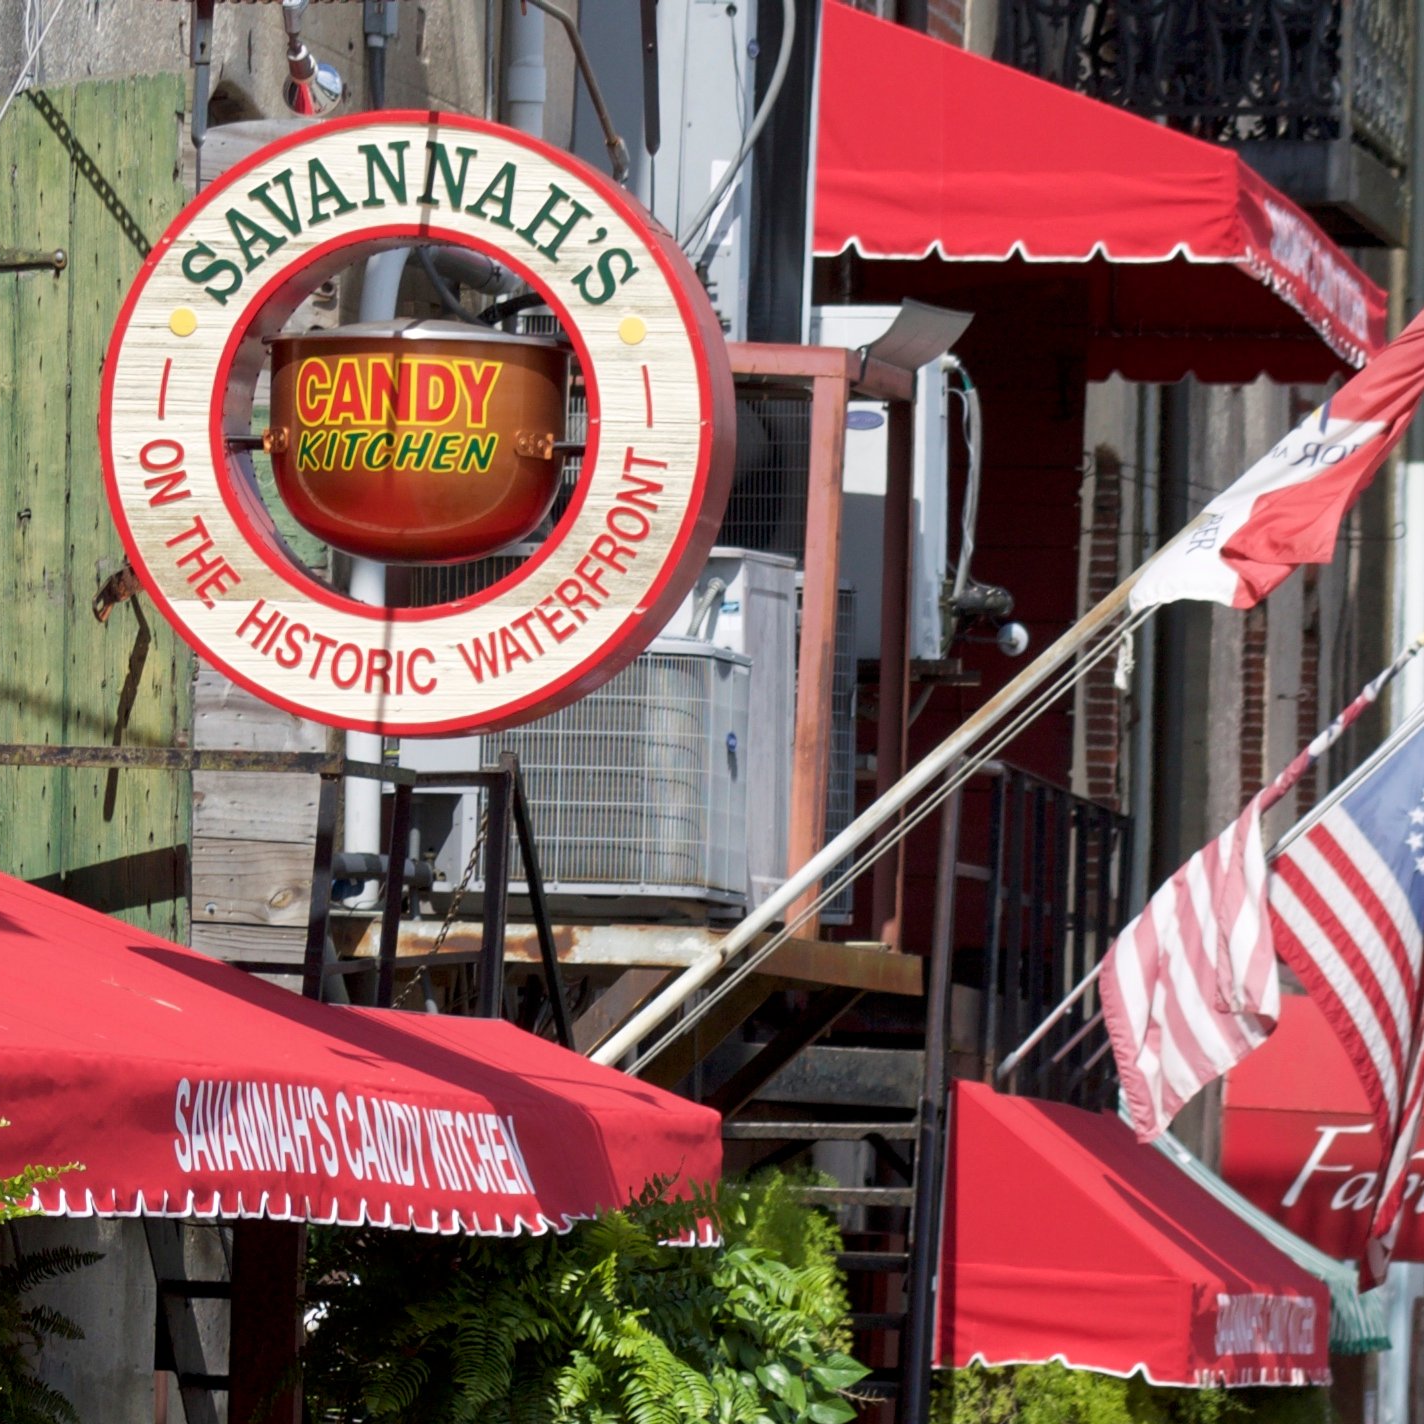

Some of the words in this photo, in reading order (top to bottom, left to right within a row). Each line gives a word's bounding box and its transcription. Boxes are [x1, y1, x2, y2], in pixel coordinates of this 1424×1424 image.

[180, 139, 640, 307] SAVANNAH'S
[296, 355, 503, 429] CANDY
[138, 437, 192, 509] ON
[296, 429, 499, 475] KITCHEN
[164, 514, 242, 611] THE
[455, 446, 670, 686] WATERFRONT
[235, 596, 438, 697] HISTORIC
[174, 1076, 340, 1179] SAVANNAH'S
[336, 1094, 428, 1189] CANDY
[425, 1107, 537, 1196] KITCHEN
